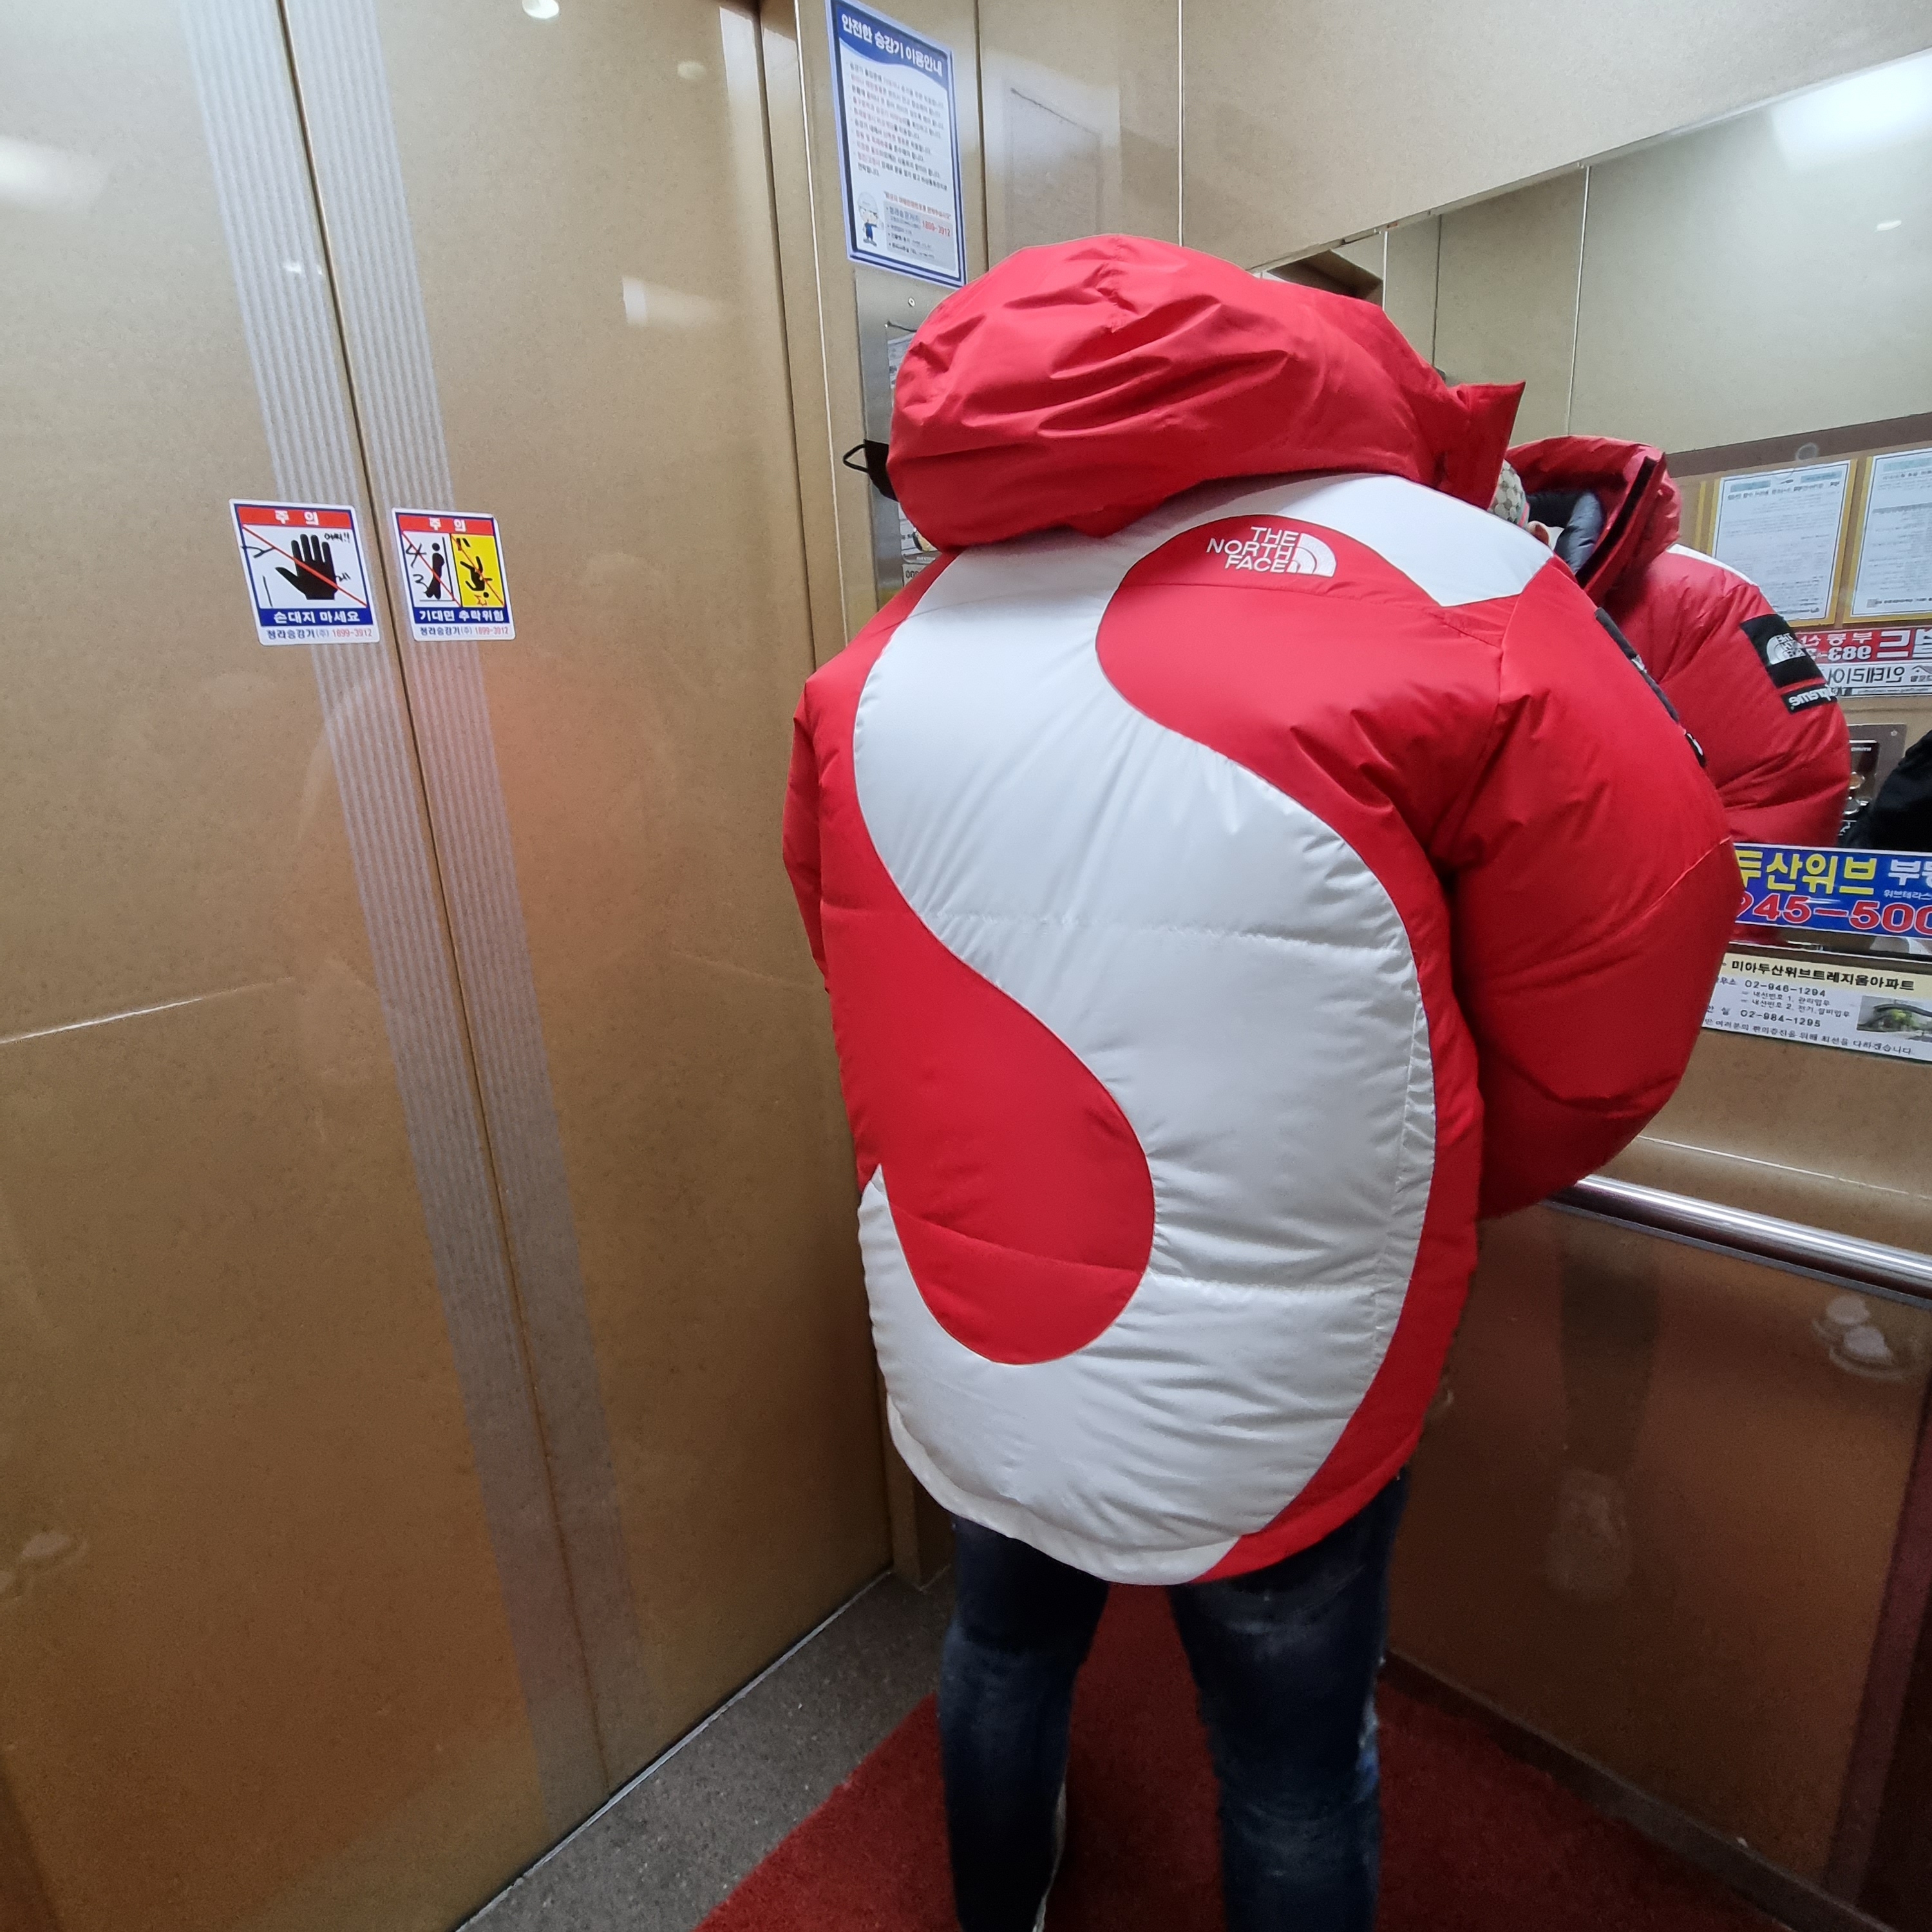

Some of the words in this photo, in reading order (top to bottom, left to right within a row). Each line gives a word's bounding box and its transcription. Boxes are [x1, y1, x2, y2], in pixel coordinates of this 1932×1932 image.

[841, 14, 873, 44] 안전한
[875, 30, 904, 59] 승강기
[905, 46, 943, 77] 이용안내
[1251, 526, 1299, 546] THE
[1206, 537, 1294, 560] NORTH
[1225, 554, 1289, 573] FACE
[274, 611, 316, 624] 손대지
[320, 611, 361, 623] 마세요
[419, 611, 455, 622] 기대면
[459, 610, 504, 622] 추락위험
